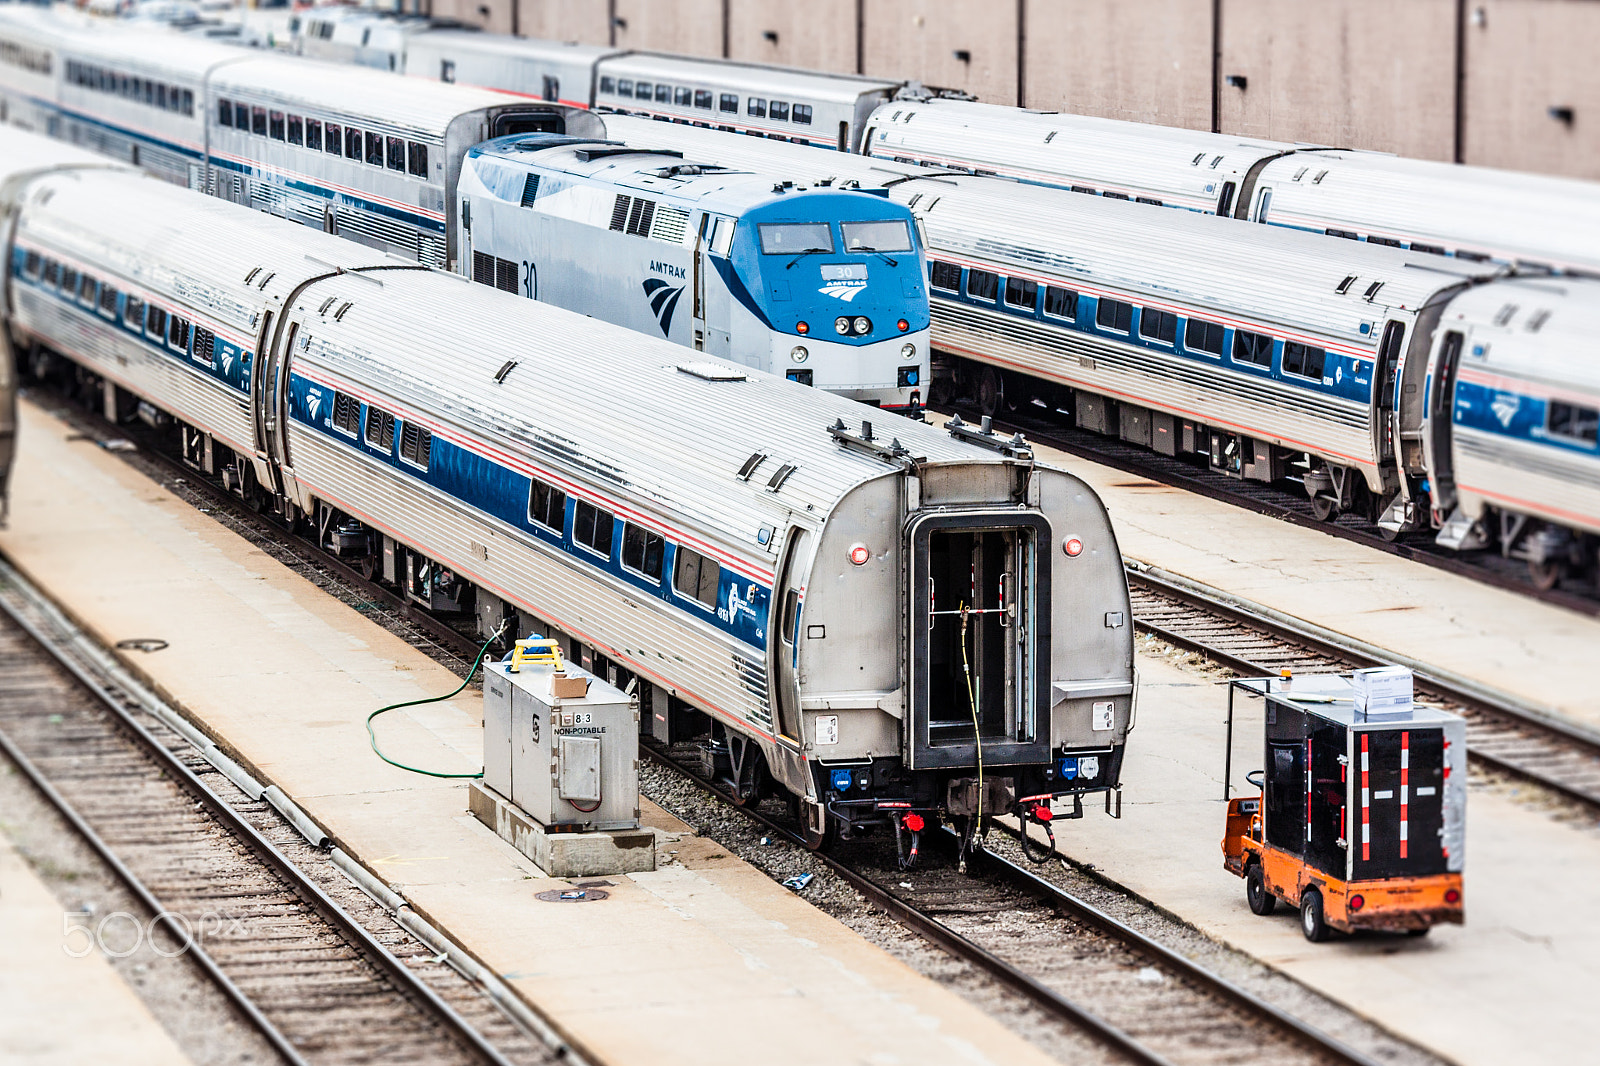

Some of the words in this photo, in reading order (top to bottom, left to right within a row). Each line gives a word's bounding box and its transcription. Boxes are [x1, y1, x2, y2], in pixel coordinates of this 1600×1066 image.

[650, 259, 686, 280] AMTRAK
[836, 266, 853, 279] 30
[522, 259, 538, 300] 30
[554, 726, 606, 735] NON-POTABLE
